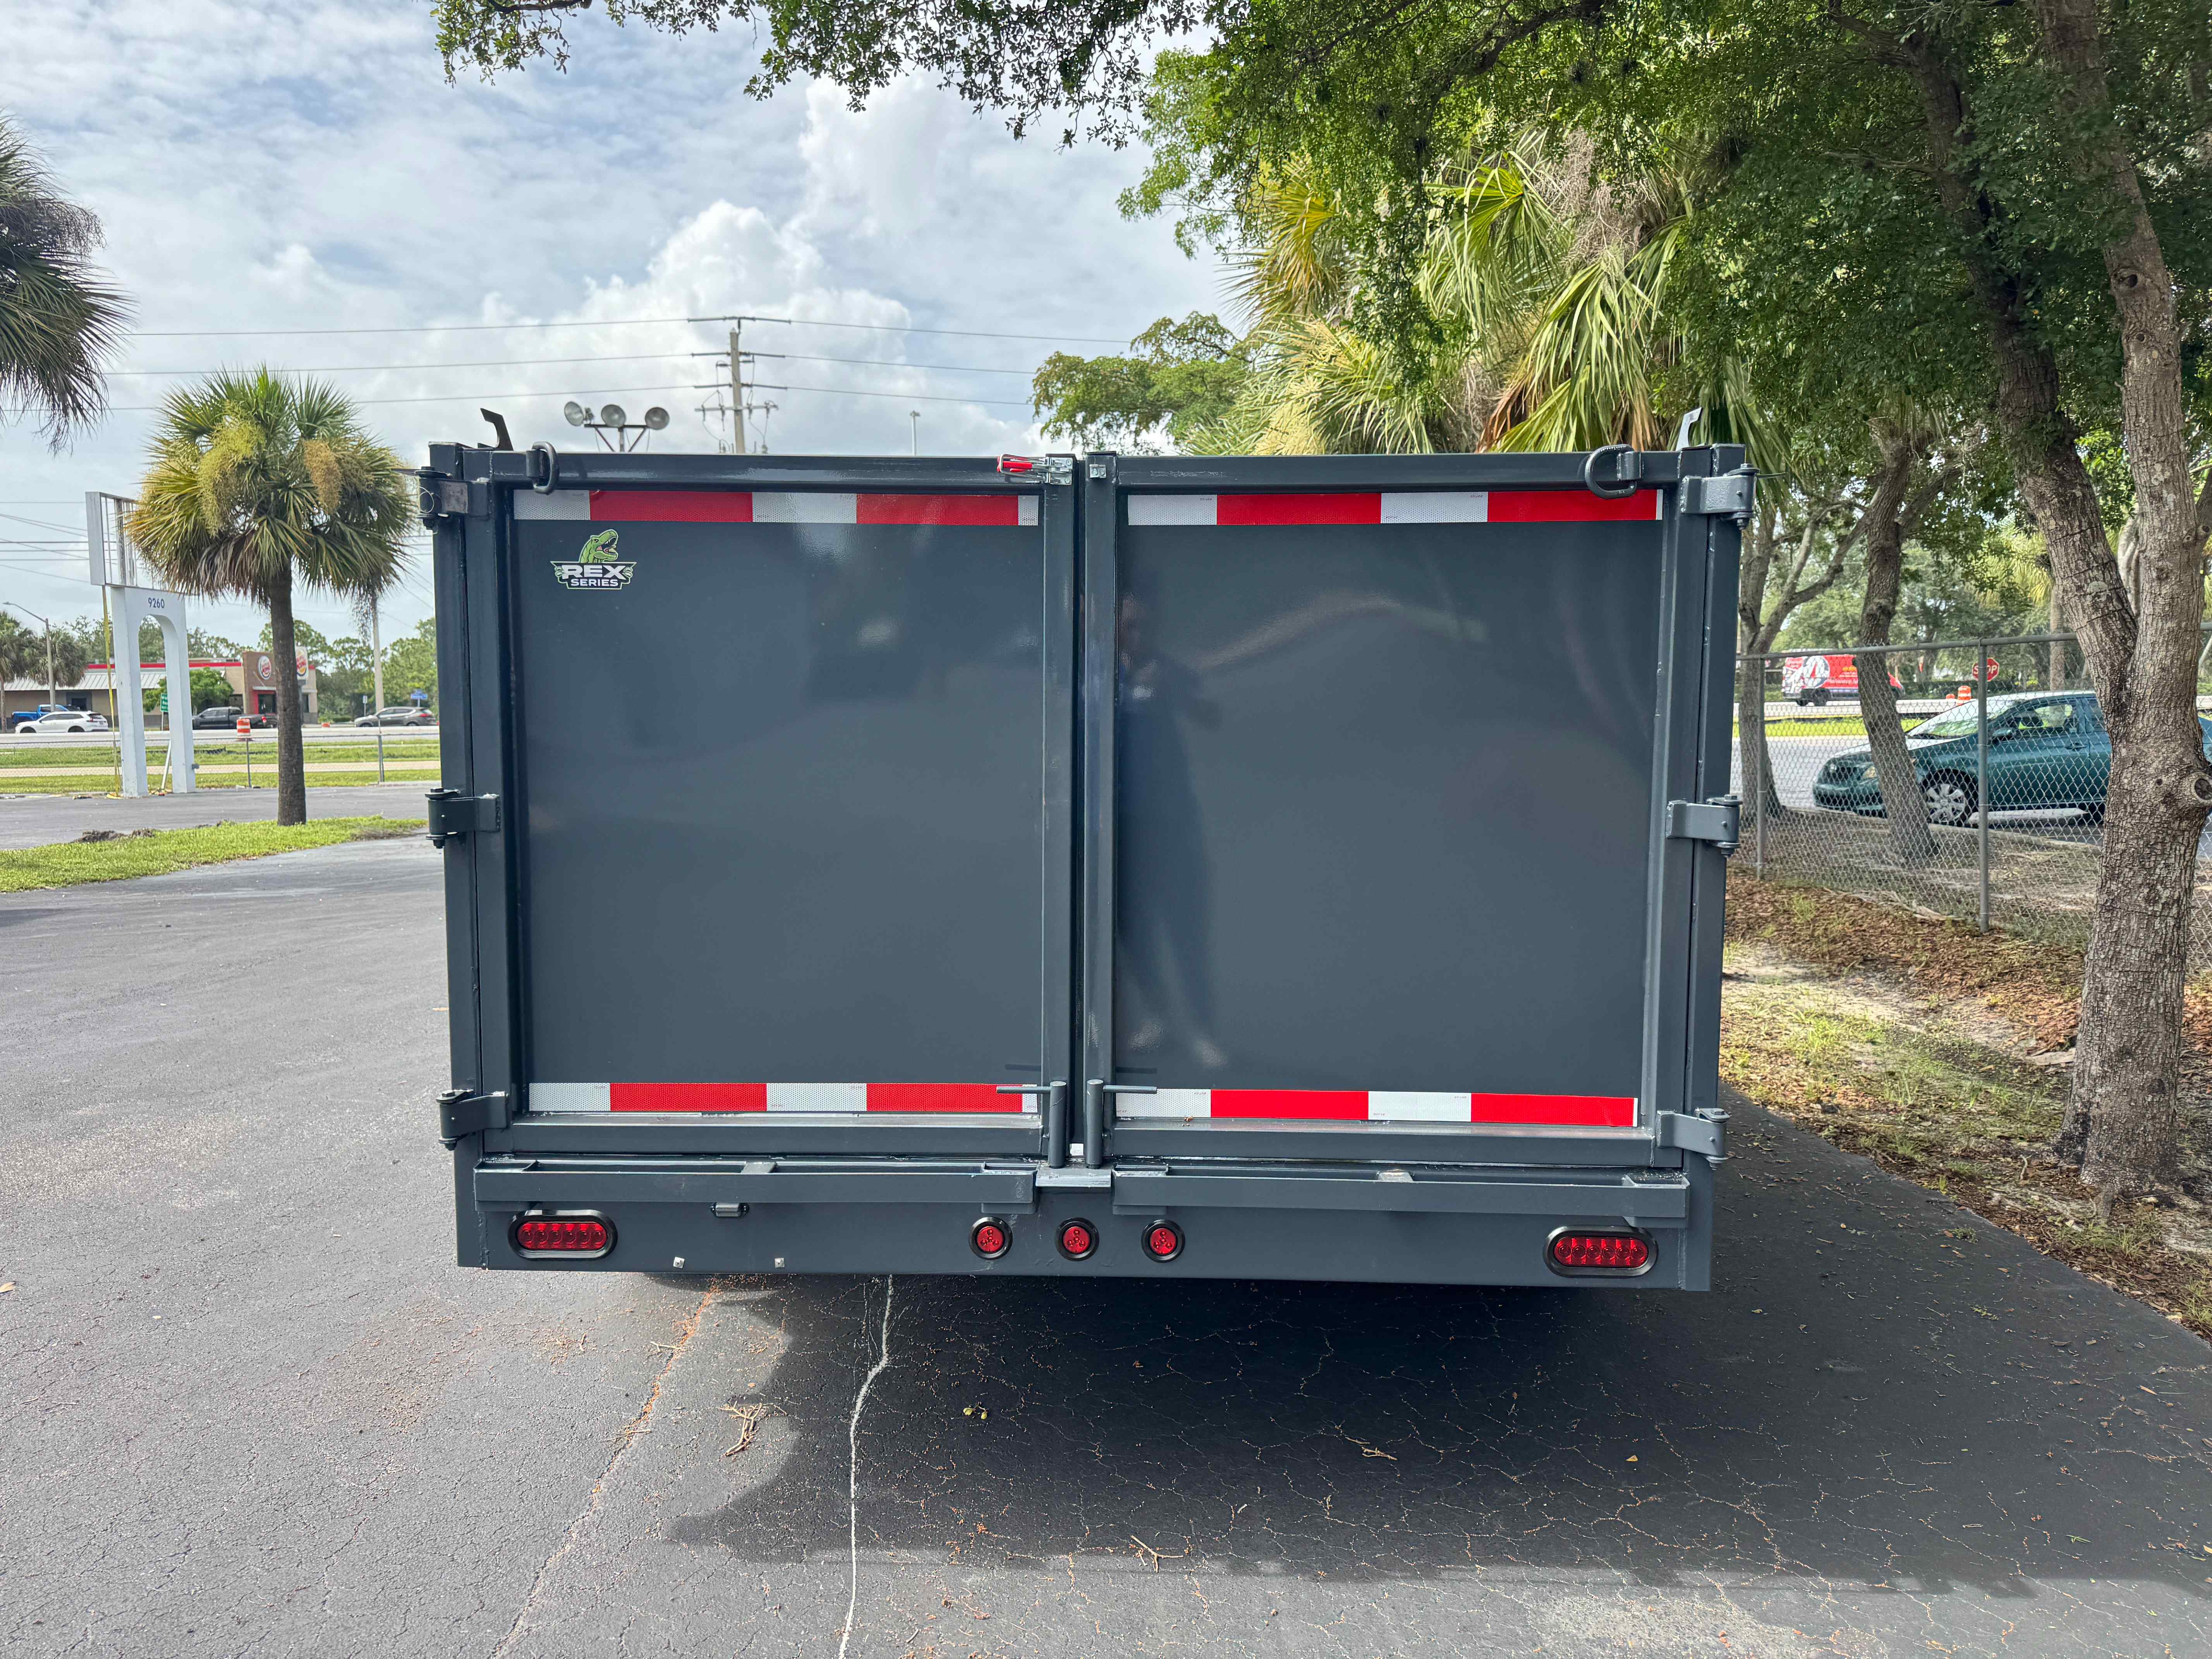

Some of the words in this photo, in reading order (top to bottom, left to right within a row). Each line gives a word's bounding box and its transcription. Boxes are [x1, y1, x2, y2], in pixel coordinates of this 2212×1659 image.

[562, 565, 626, 580] REX
[148, 597, 165, 608] 9260
[1973, 665, 1997, 674] SOP
